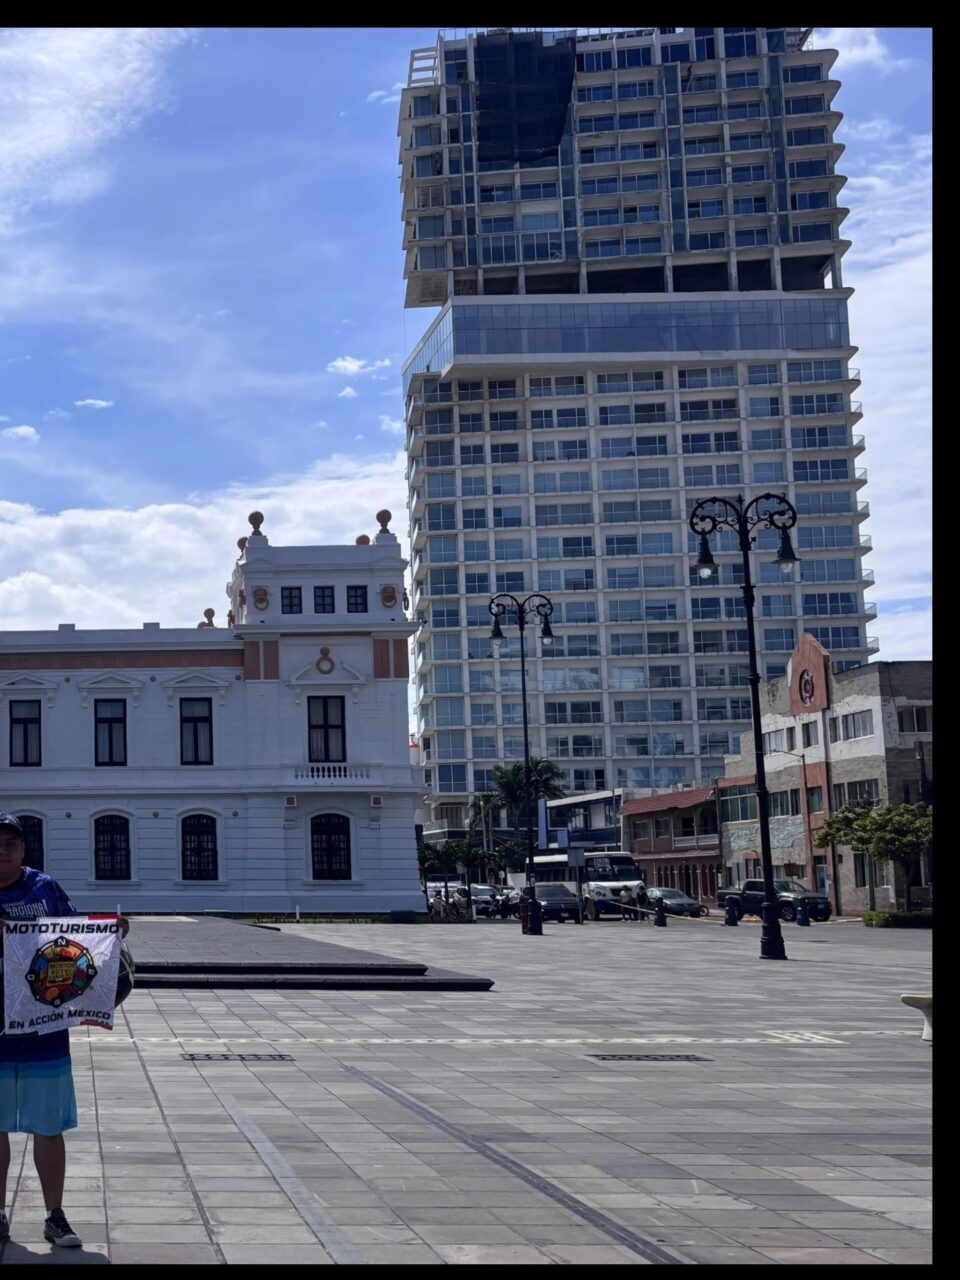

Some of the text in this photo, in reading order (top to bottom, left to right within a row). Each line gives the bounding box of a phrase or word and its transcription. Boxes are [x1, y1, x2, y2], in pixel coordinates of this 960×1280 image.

[5, 922, 120, 935] MOTOTURISMO
[57, 938, 66, 946] N
[9, 1008, 111, 1030] EN ACCIÓN MÉXICO
